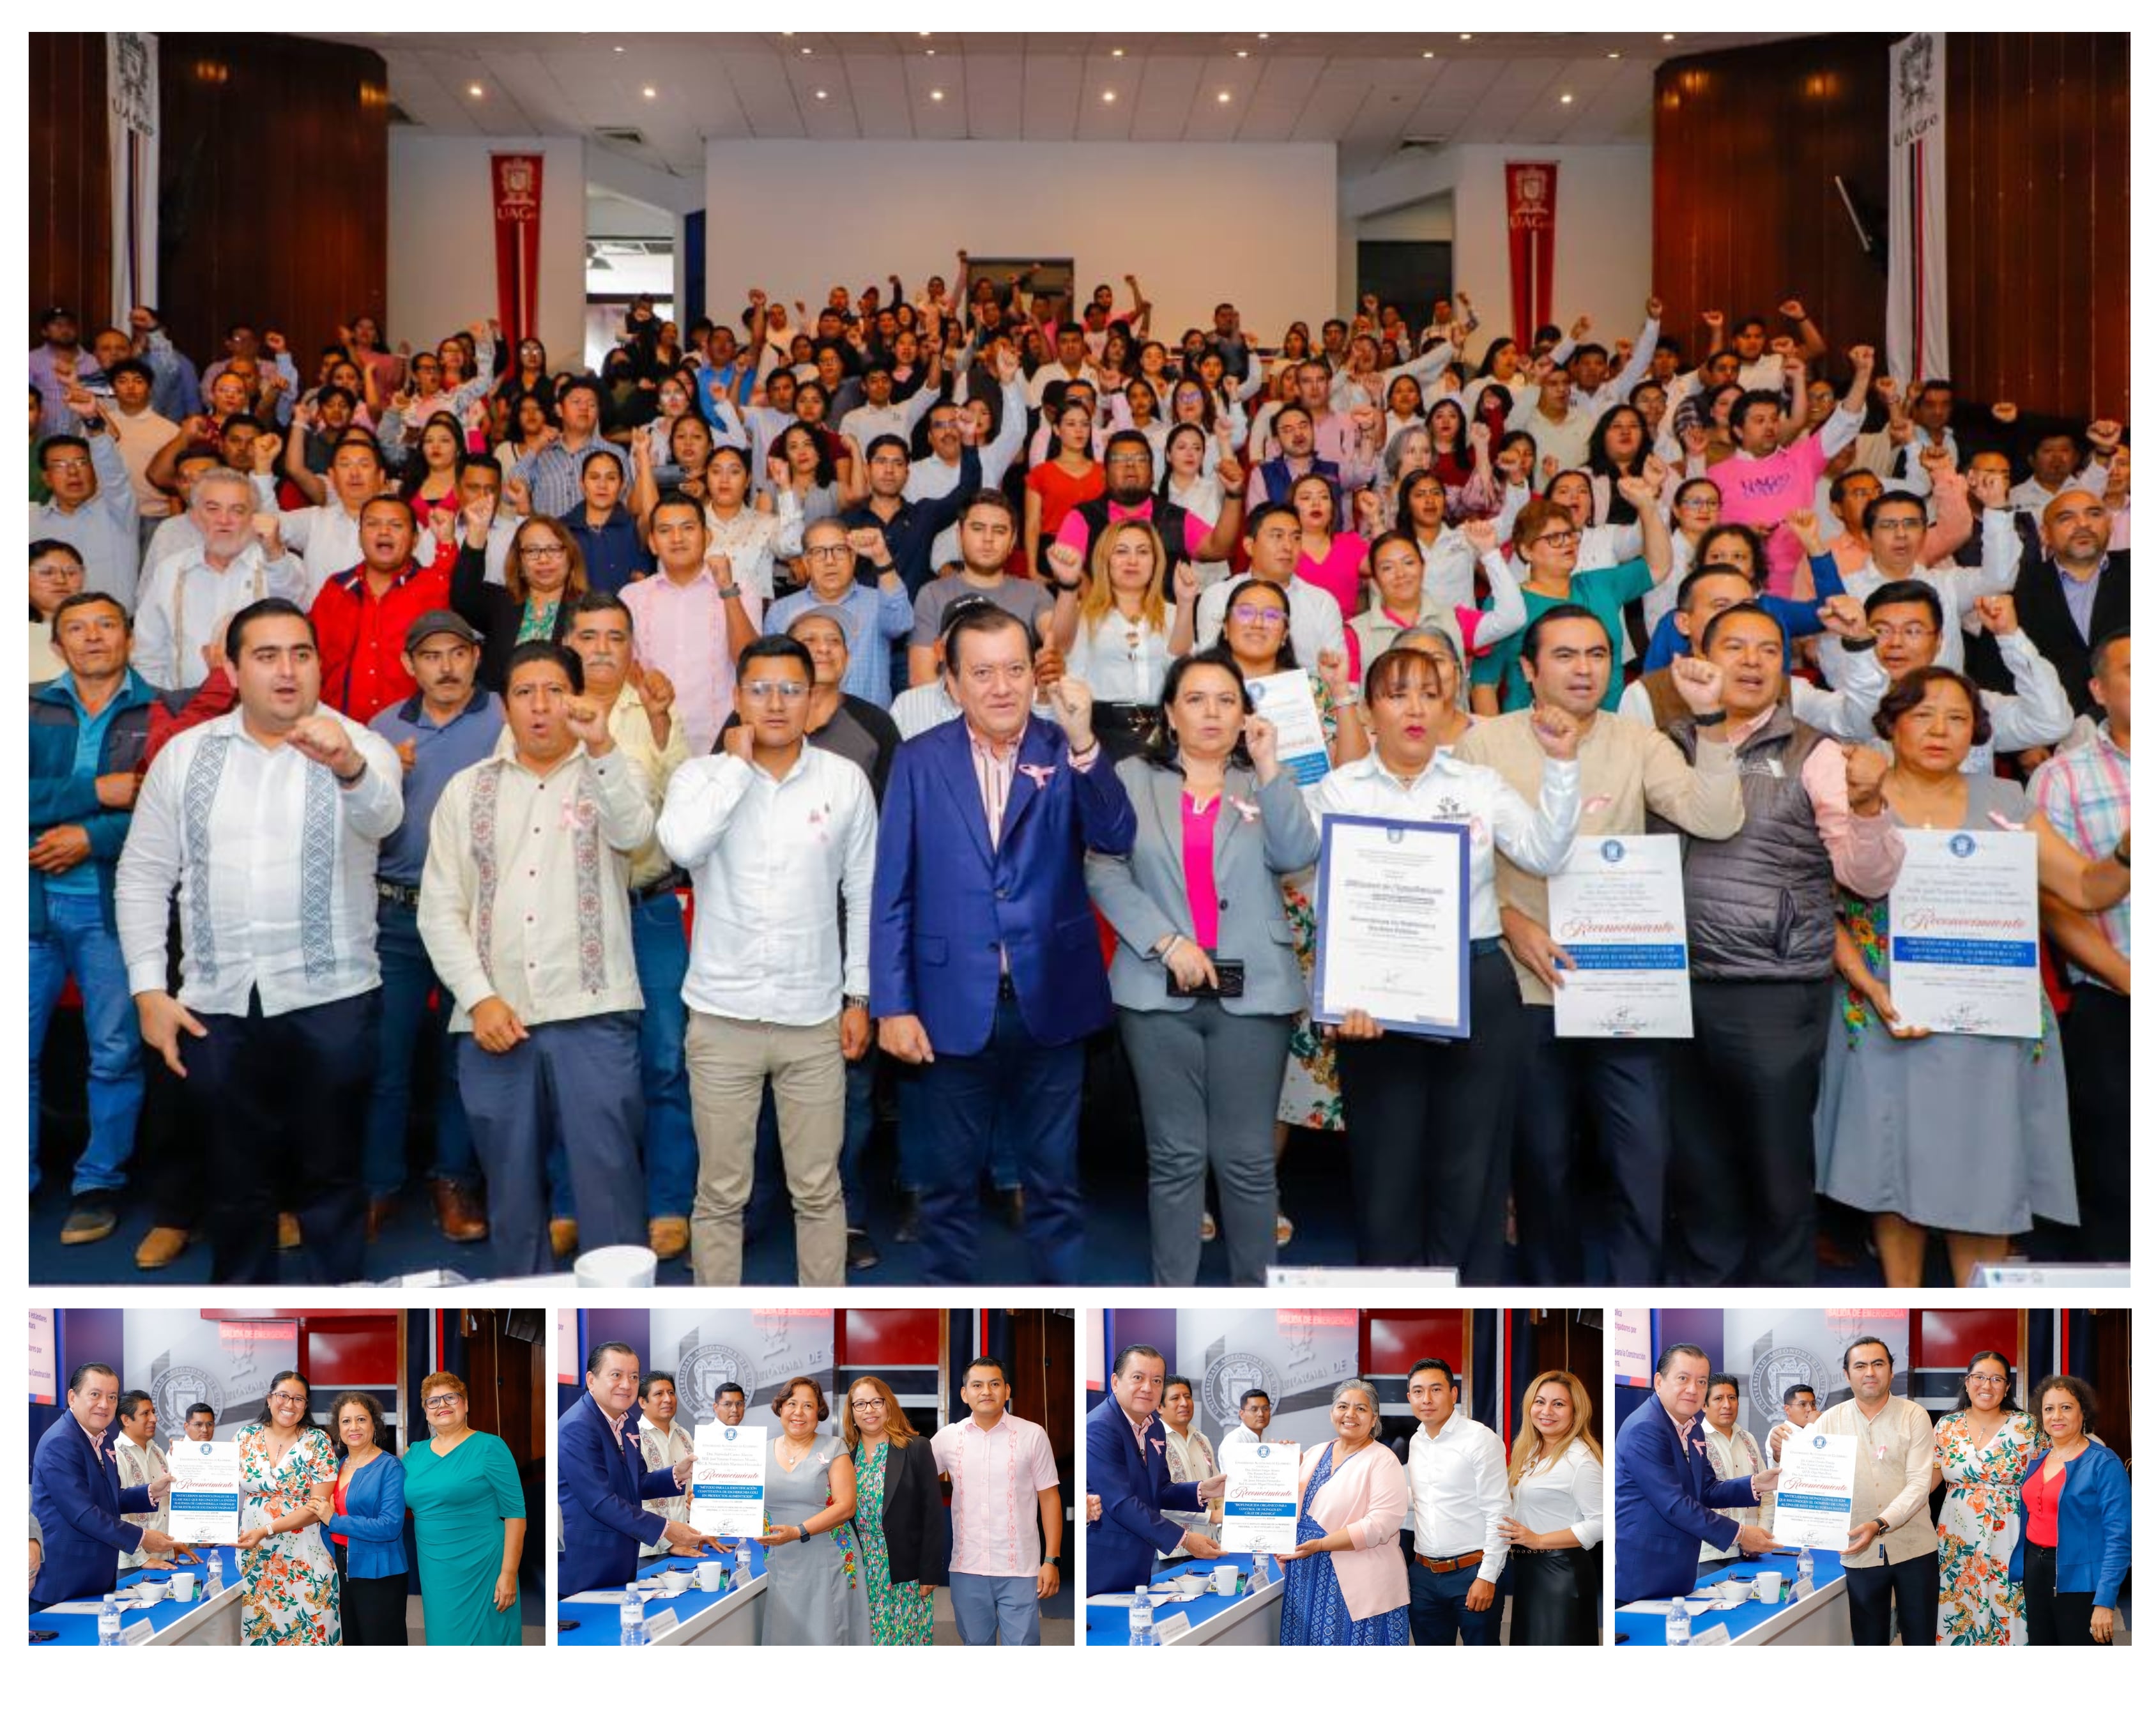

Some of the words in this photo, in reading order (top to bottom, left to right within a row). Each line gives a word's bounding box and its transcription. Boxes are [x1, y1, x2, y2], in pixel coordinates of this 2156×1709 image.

[807, 1351, 823, 1365] DE
[1332, 1360, 1347, 1374] DE
[698, 1468, 759, 1480] Reconocimiento
[176, 1478, 233, 1489] Reconocimiento
[1784, 1477, 1847, 1491] Reconocimiento
[1230, 1486, 1292, 1498] Reconocimiento
